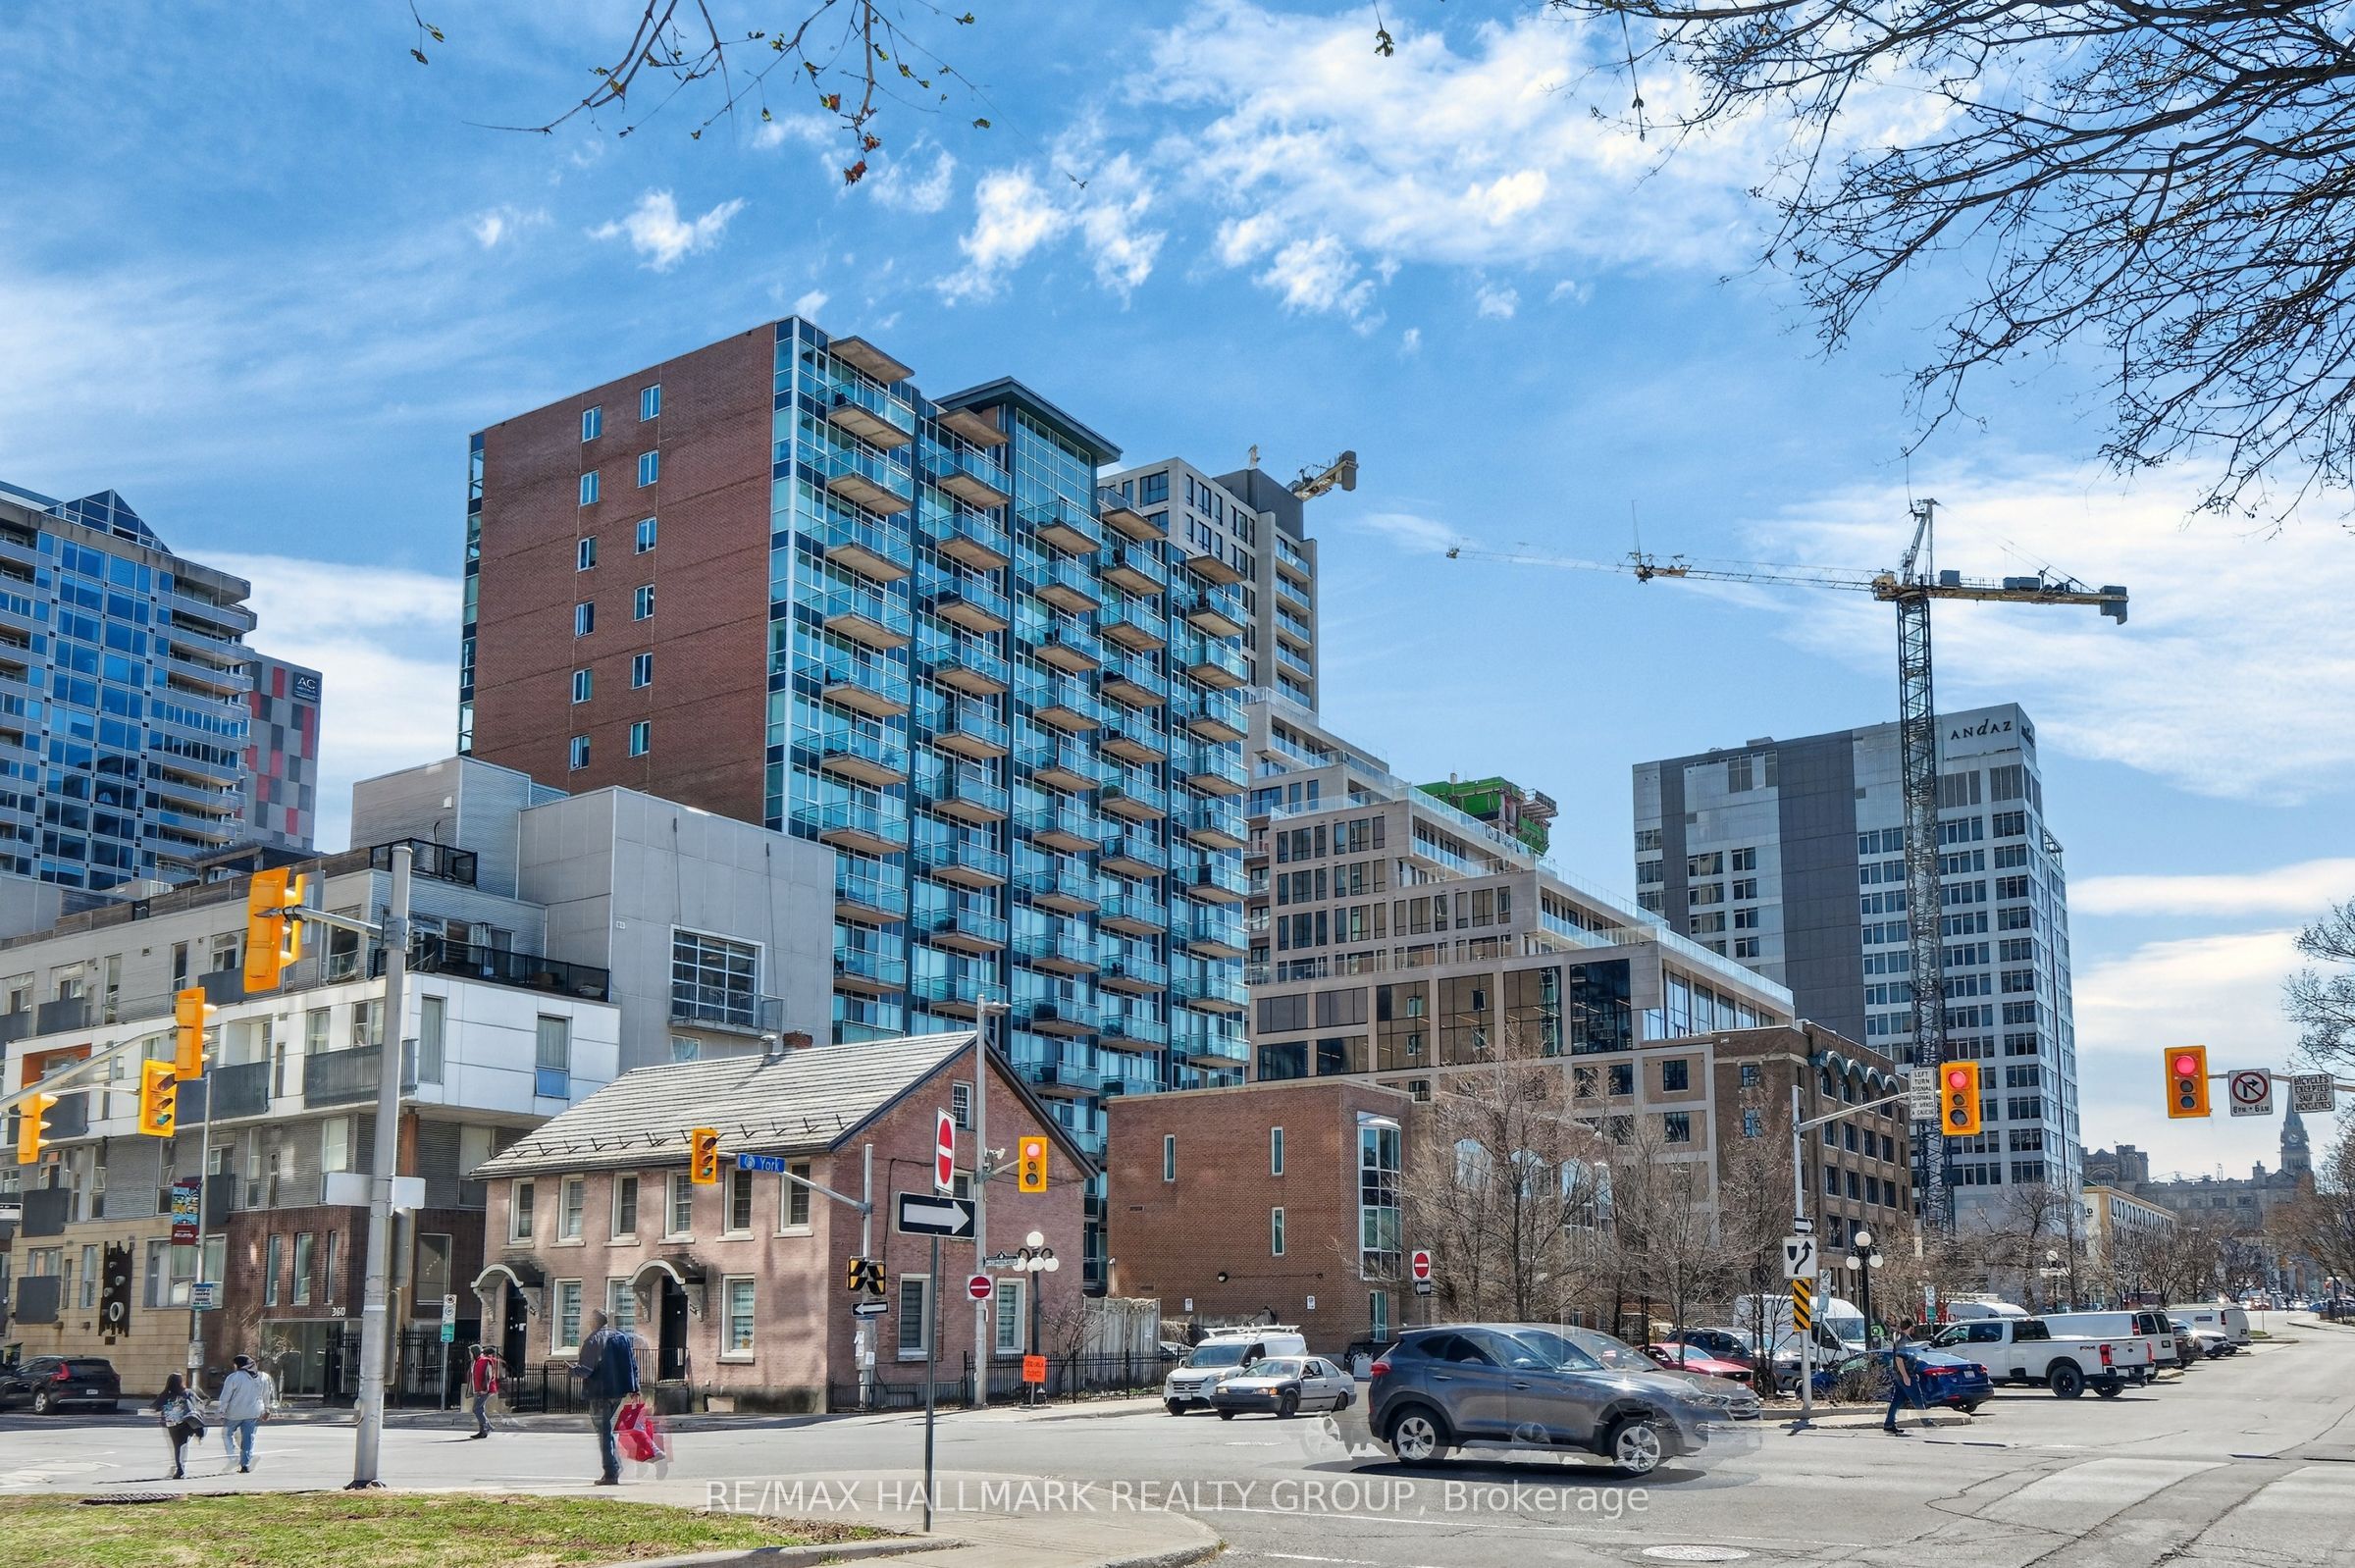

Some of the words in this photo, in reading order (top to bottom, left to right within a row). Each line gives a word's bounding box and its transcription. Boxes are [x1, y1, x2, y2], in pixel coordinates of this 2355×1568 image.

[297, 677, 316, 690] AC
[2294, 1075, 2329, 1085] BICYCLES
[759, 1158, 780, 1173] York
[331, 1306, 346, 1317] 360
